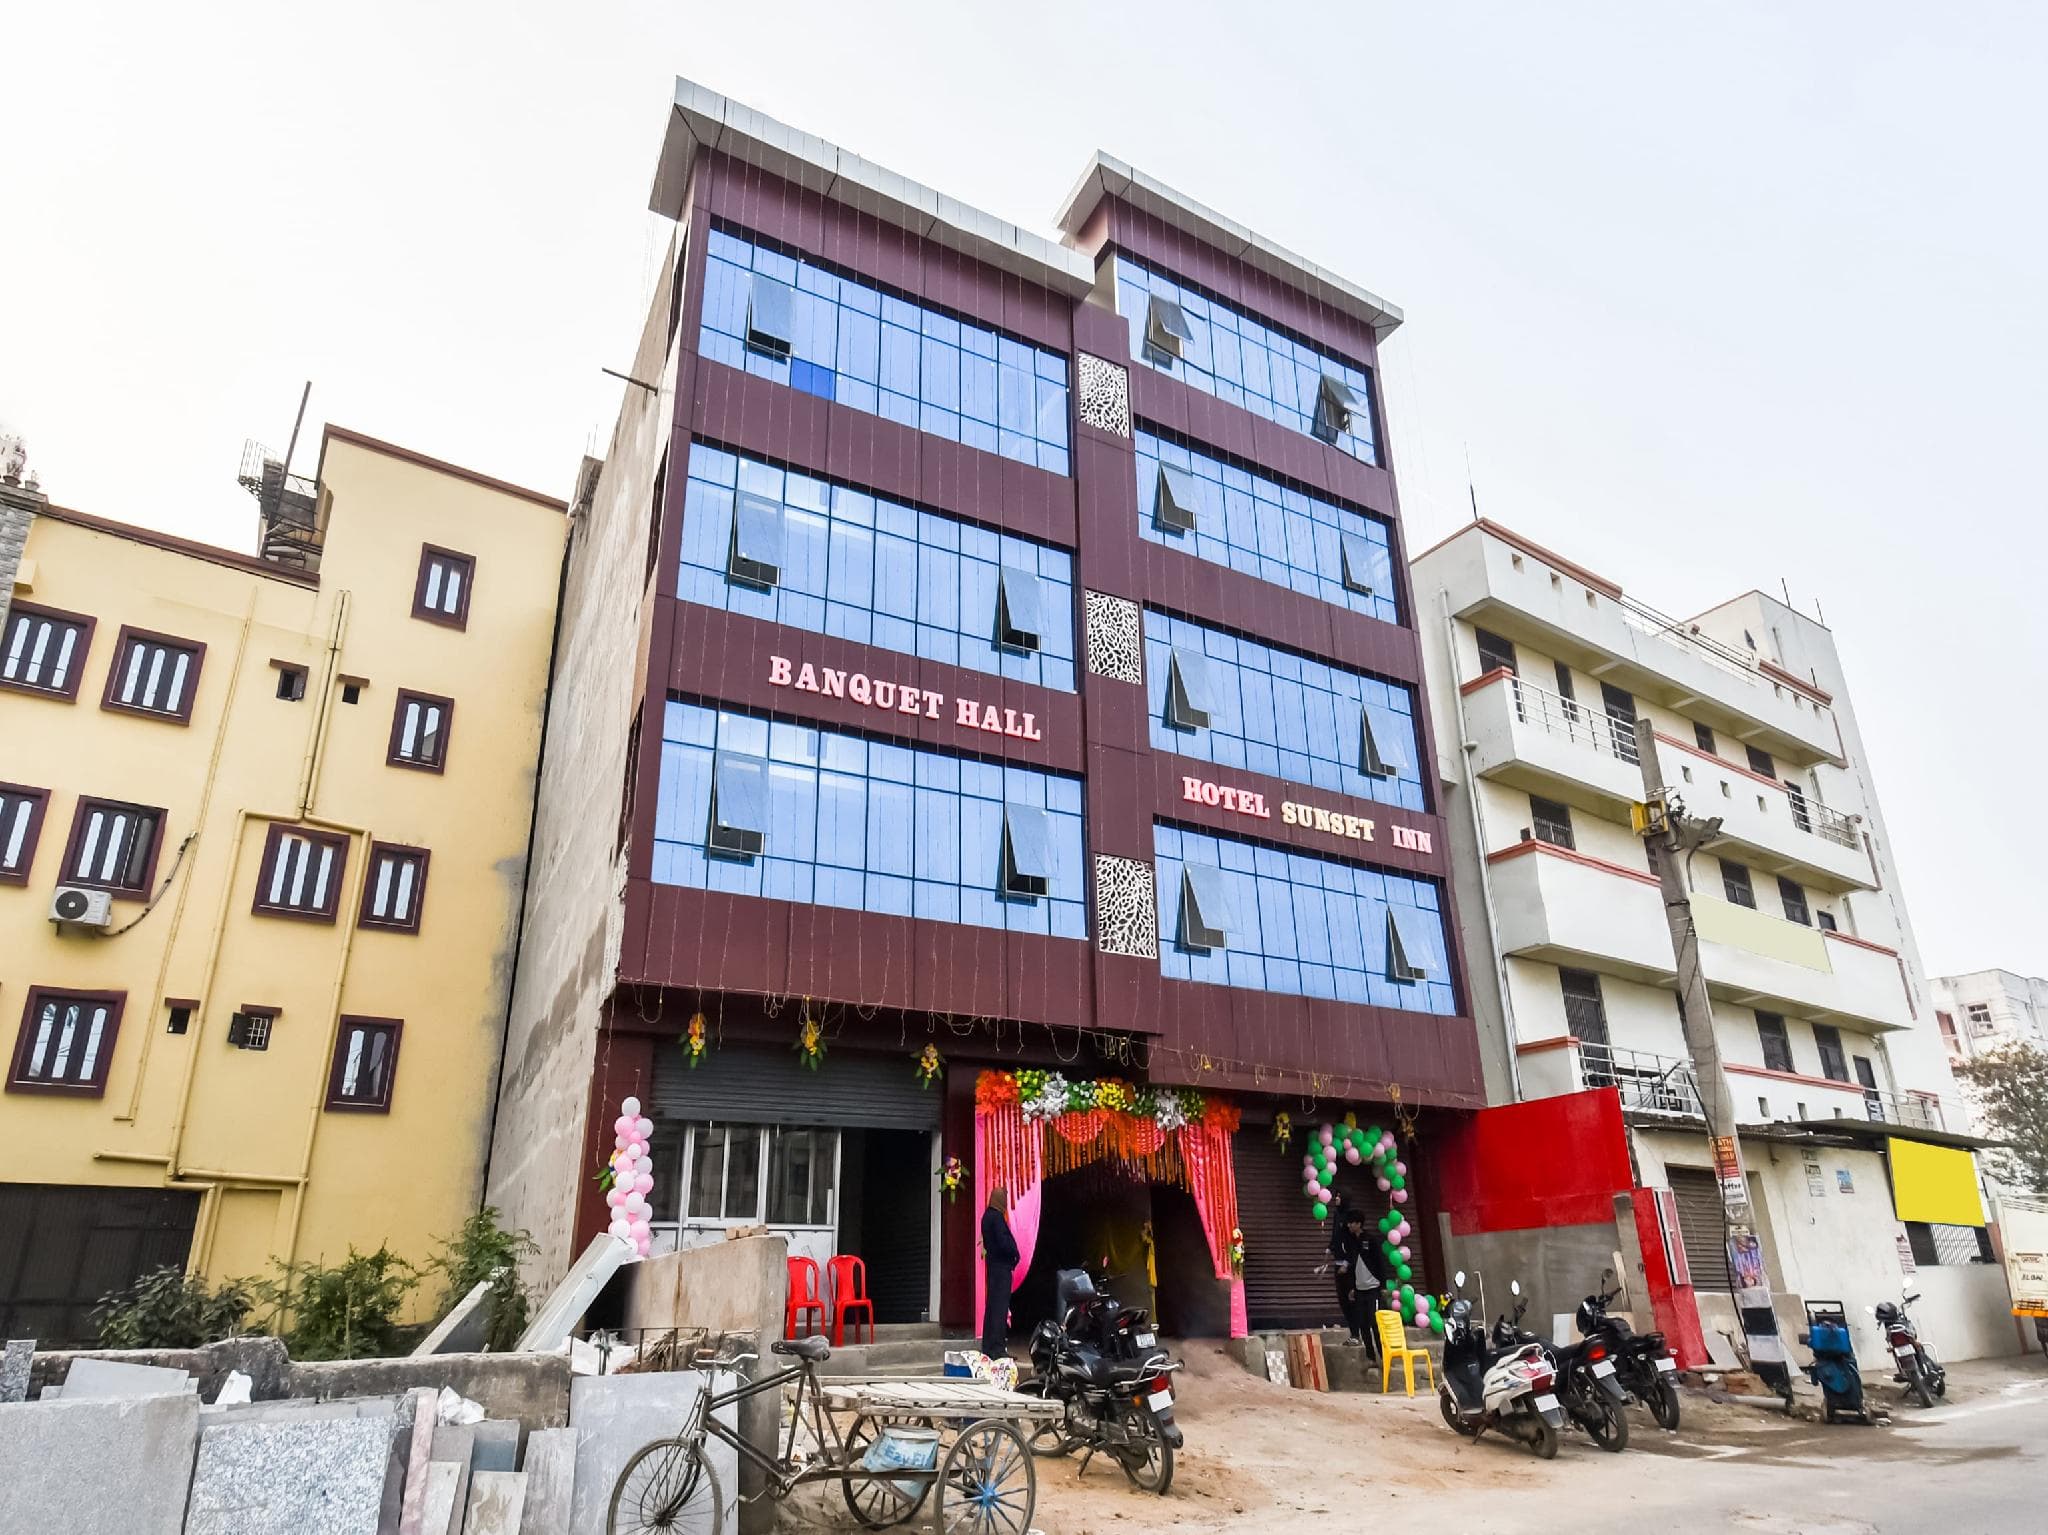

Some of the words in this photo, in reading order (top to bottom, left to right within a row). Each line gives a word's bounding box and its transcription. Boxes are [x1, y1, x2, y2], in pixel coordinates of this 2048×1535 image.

[769, 656, 943, 719] BANQUET
[956, 698, 1040, 741] HALL
[1182, 776, 1270, 818] HOTEL
[1281, 801, 1375, 842] SUNSET
[1391, 825, 1432, 854] INN
